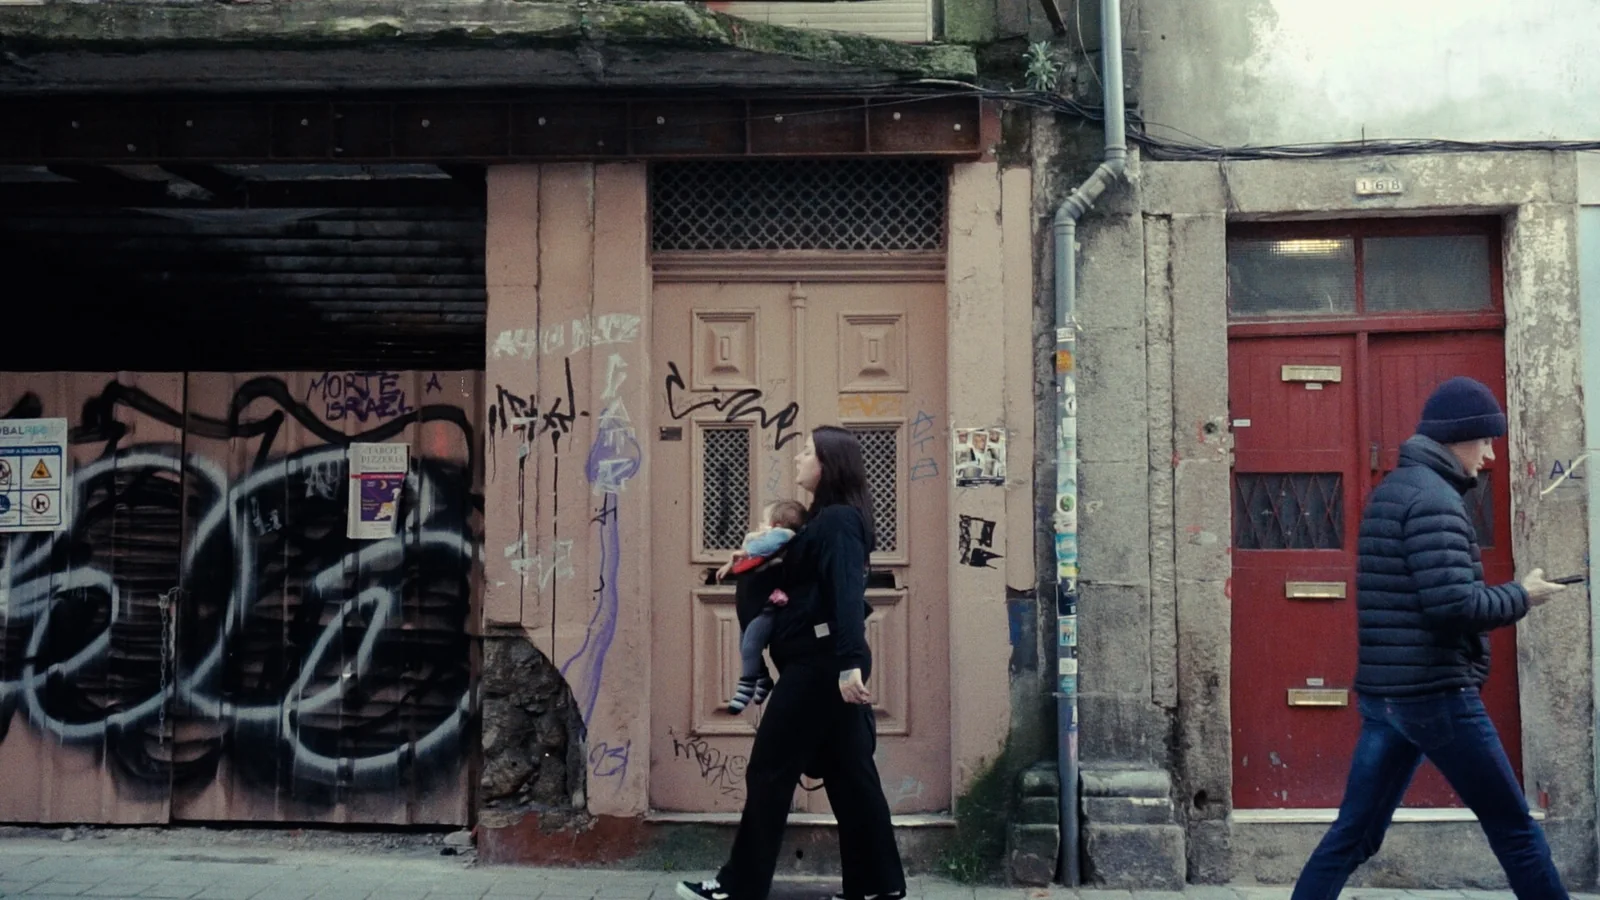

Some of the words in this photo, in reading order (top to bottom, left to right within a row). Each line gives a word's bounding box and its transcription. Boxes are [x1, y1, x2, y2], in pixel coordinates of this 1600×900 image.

[1361, 180, 1400, 191] 168
[306, 371, 400, 400] MORTE
[325, 392, 413, 421] ISRAEL
